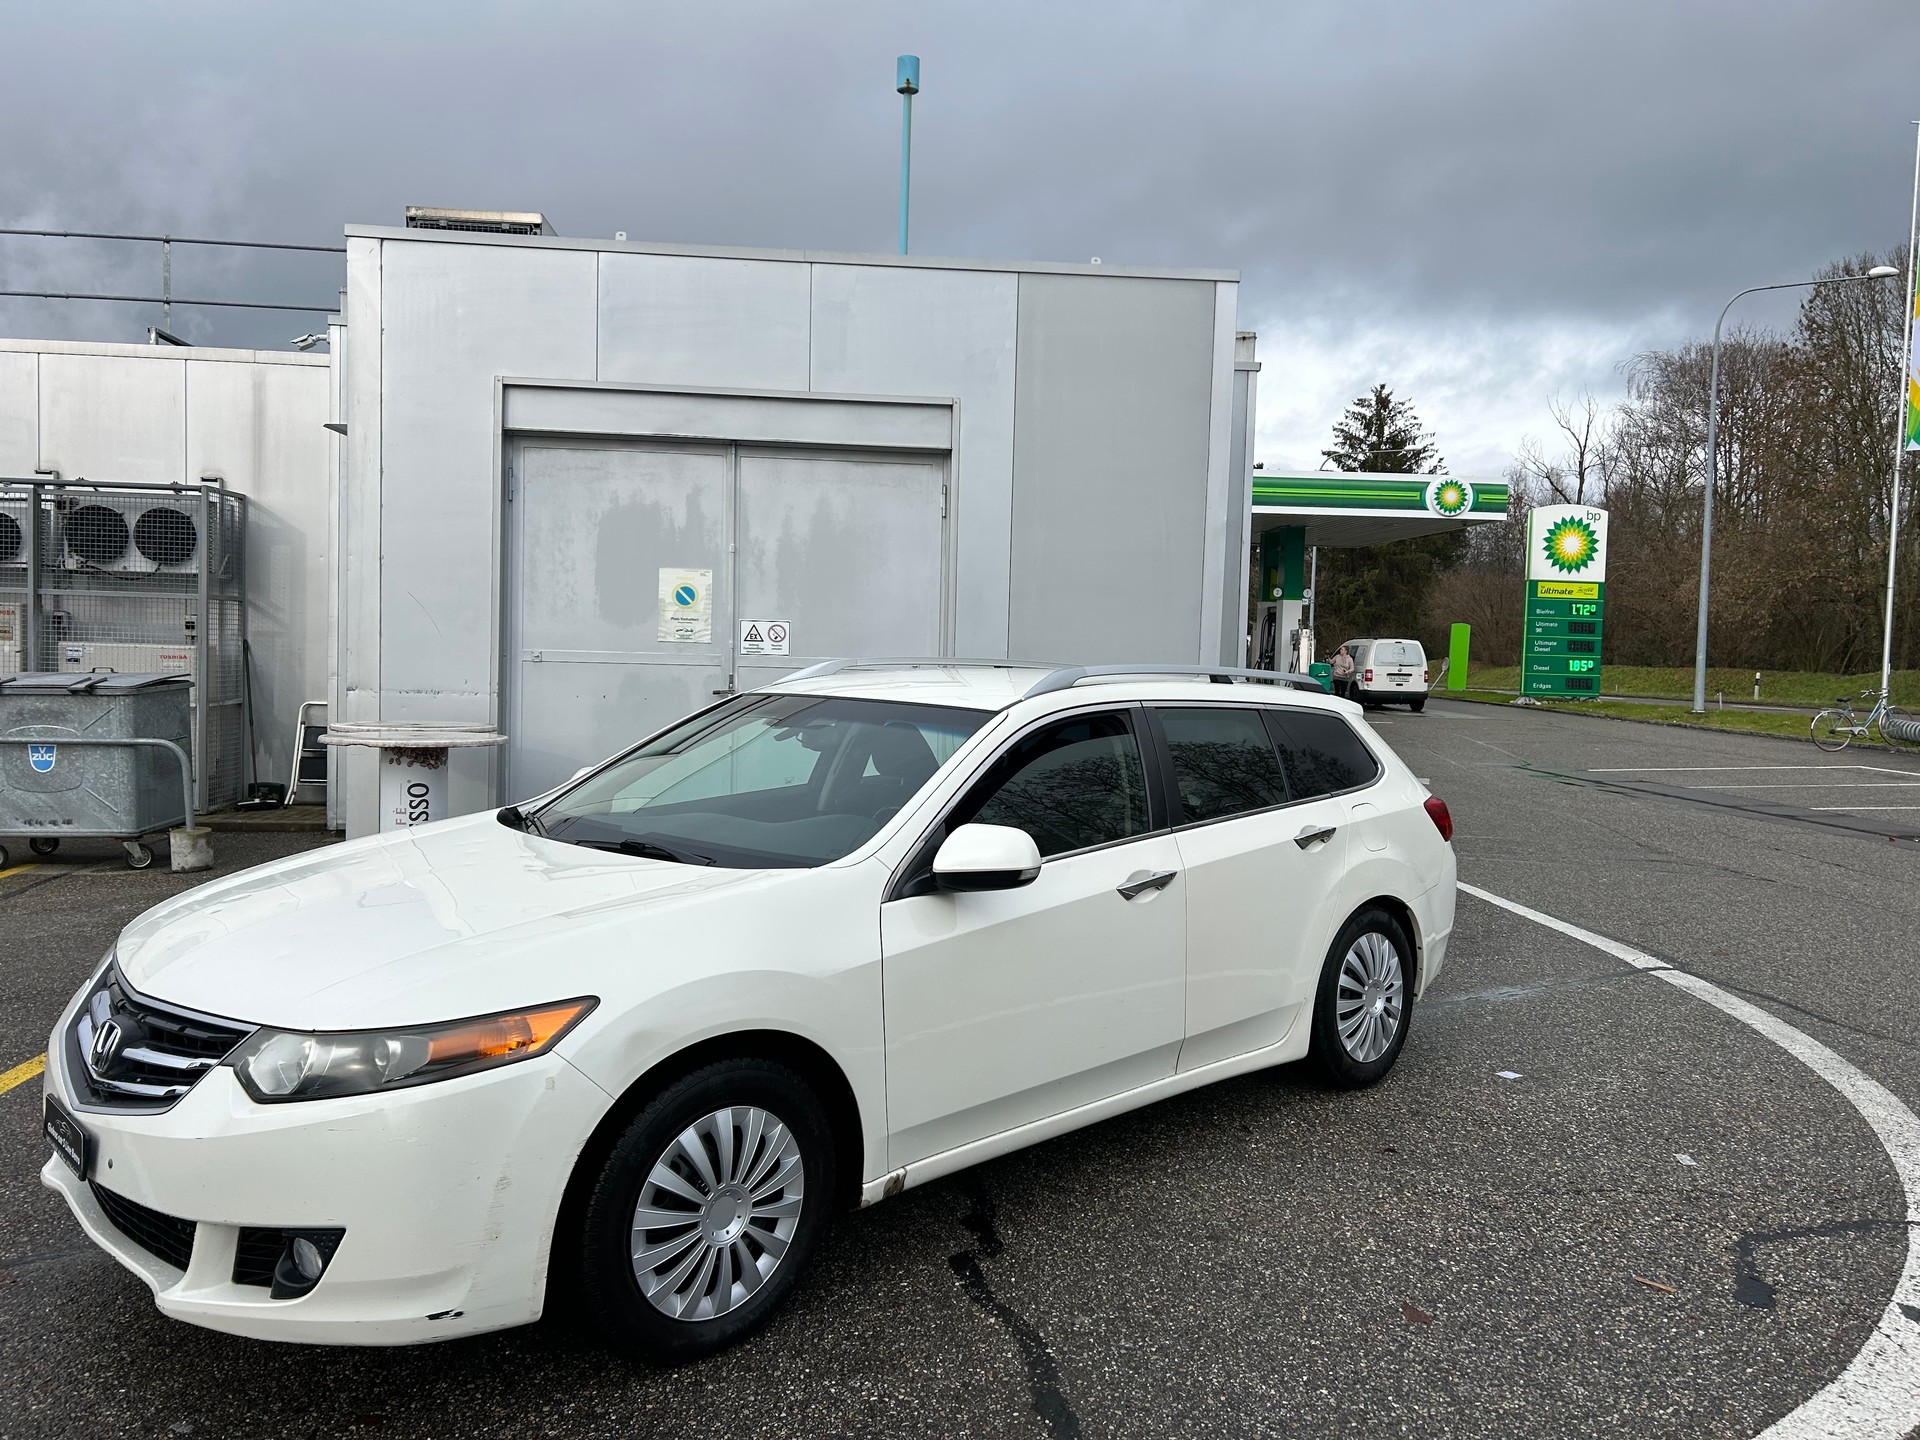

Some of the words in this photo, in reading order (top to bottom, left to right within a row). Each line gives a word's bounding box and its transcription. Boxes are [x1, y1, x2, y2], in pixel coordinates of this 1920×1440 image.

[1587, 510, 1601, 523] bp
[32, 753, 54, 761] ZUG
[407, 783, 429, 827] SSO
